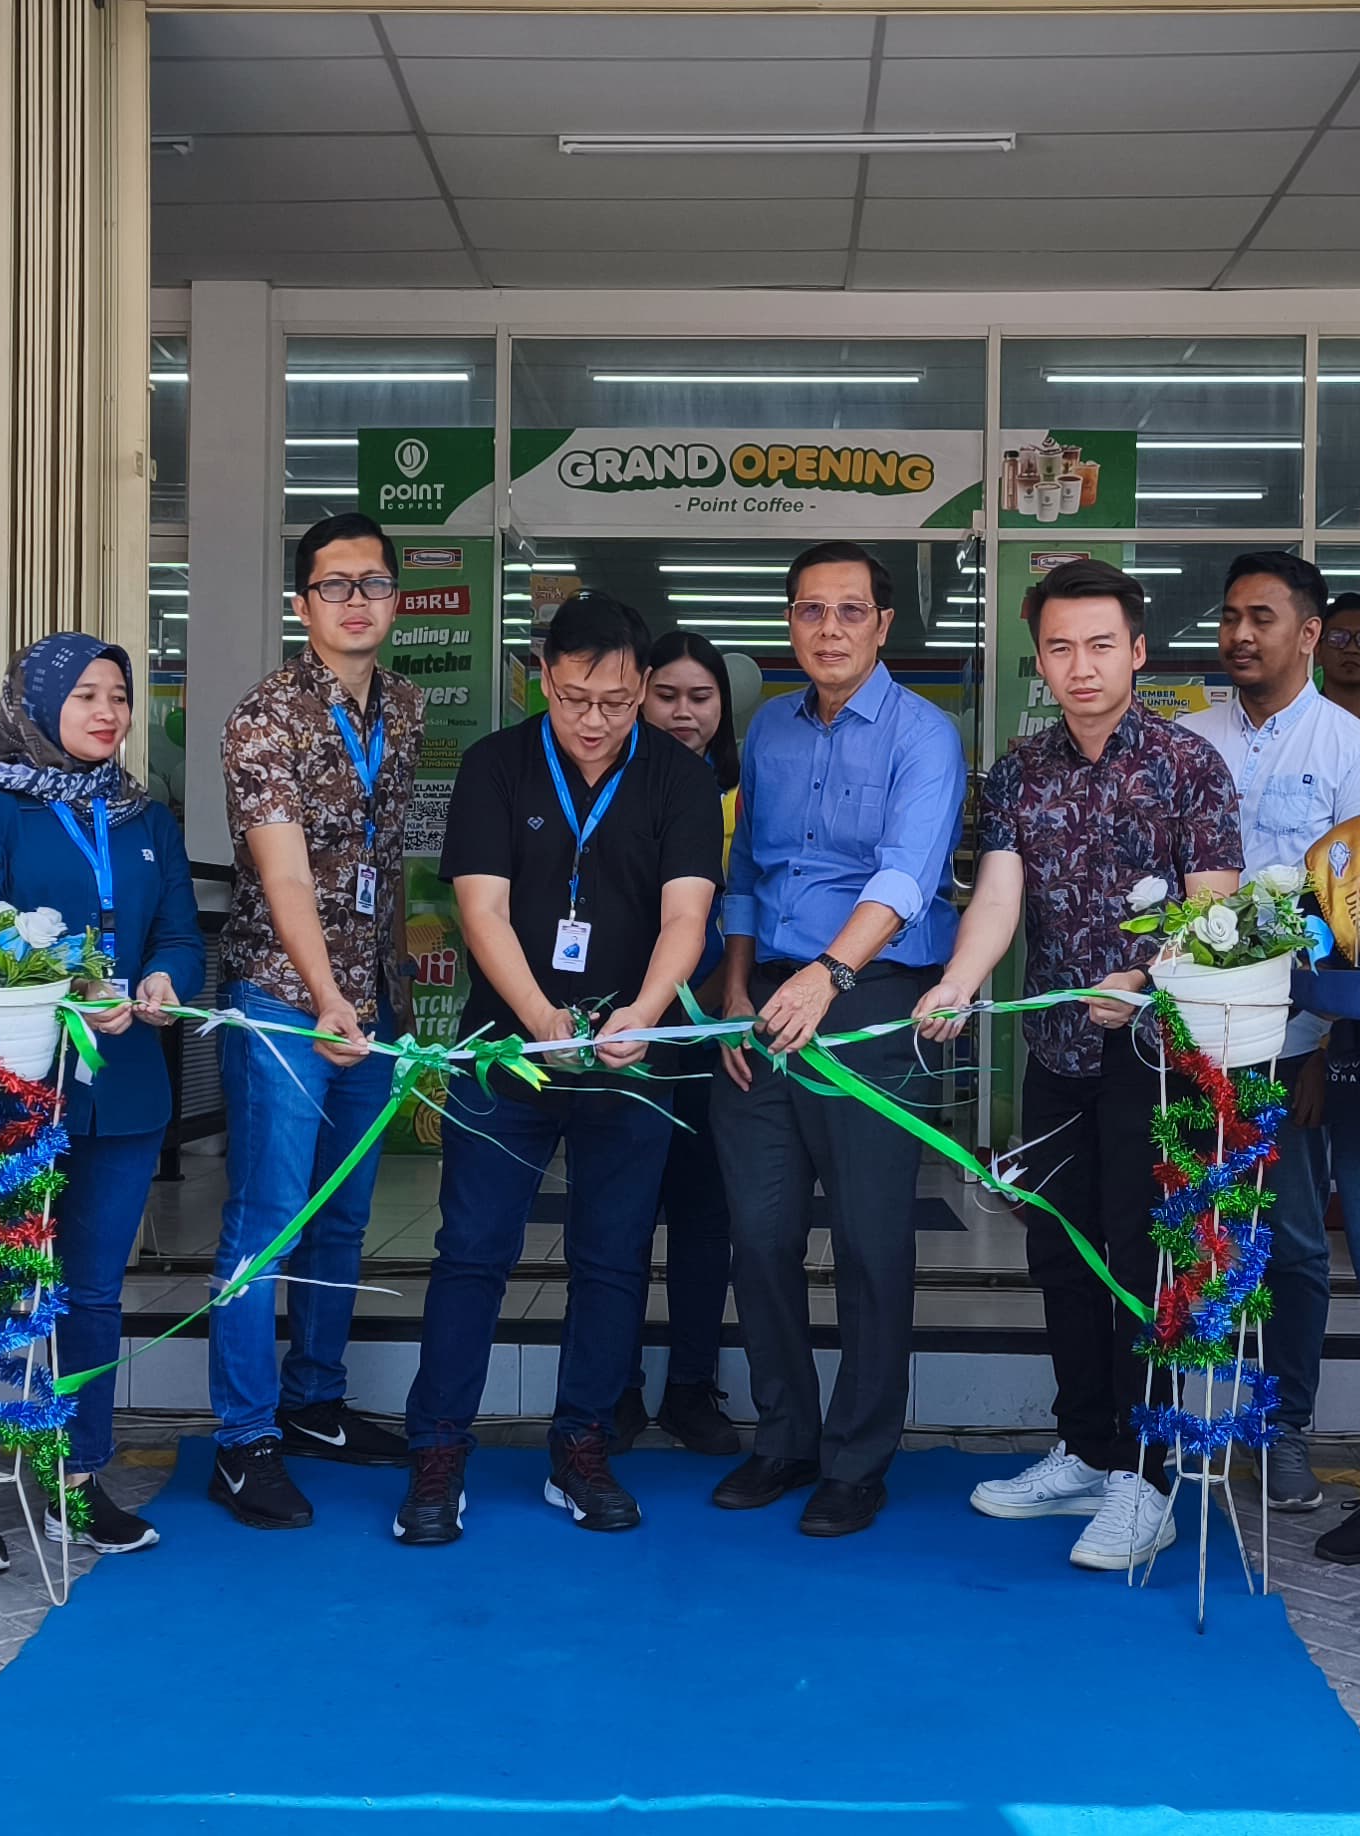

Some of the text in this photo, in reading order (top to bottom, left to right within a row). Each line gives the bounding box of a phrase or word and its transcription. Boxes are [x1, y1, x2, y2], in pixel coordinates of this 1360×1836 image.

[559, 445, 935, 493] GRAND OPENING
[686, 496, 738, 513] Point
[743, 496, 804, 513] Coffee
[406, 591, 460, 610] BARU
[391, 627, 451, 646] Calling
[391, 651, 473, 675] Matcha
